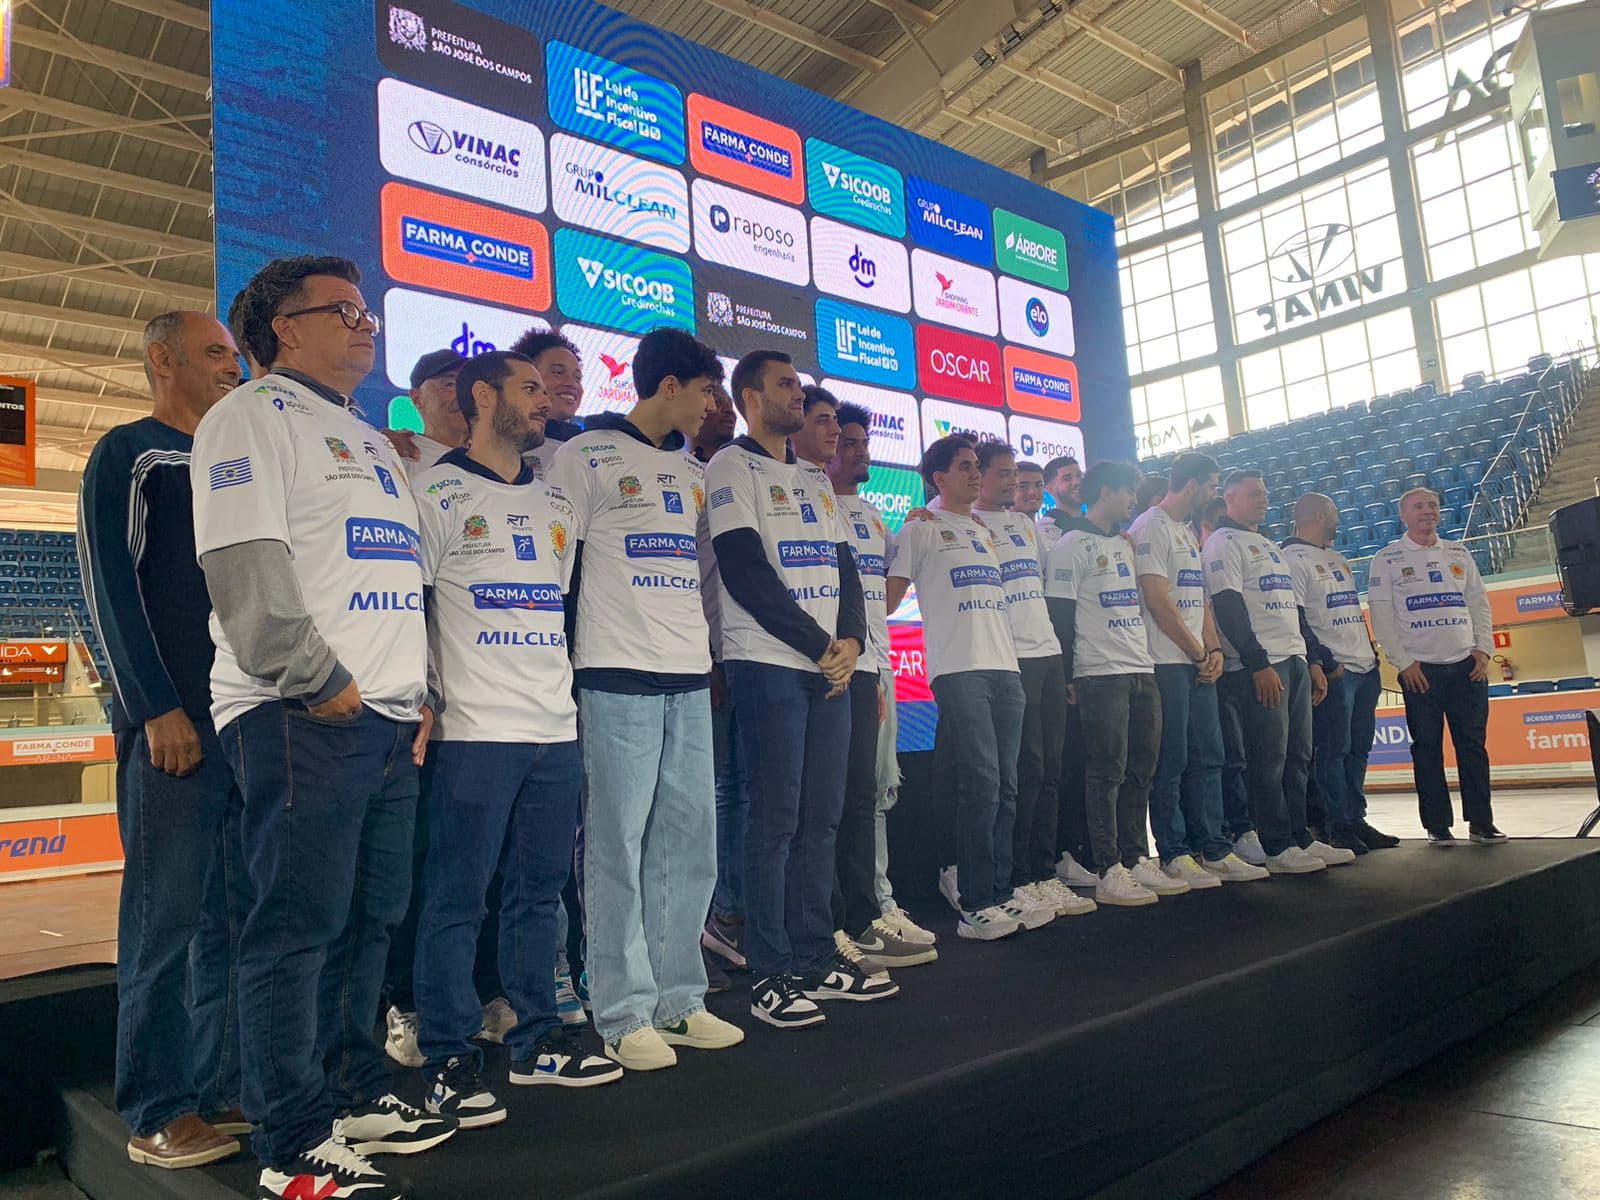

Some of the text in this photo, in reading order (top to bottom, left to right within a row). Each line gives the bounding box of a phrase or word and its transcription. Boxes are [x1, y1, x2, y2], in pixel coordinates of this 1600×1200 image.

[430, 27, 482, 55] PREFEITURA
[431, 39, 533, 85] SÃO JOSÉ DOS CAMPOS
[606, 94, 658, 123] Incentivo
[607, 111, 638, 133] Fiscal
[452, 131, 521, 166] VINAC
[704, 126, 747, 153] FARMA
[748, 142, 790, 168] CONDE
[454, 152, 519, 177] consórcios
[565, 162, 604, 183] GRUPO
[574, 178, 676, 220] MILCLEAN
[841, 173, 892, 205] SICOOB
[852, 194, 892, 216] Credirochas
[917, 197, 941, 213] GRUPO
[733, 214, 795, 248] raposo
[923, 210, 983, 241] MILCLEAN
[405, 222, 467, 252] FARMA
[467, 238, 530, 267] CONDE
[752, 243, 795, 264] engenharia
[1015, 232, 1058, 266] ÁRBORE
[602, 268, 675, 305] SICOOB
[620, 294, 676, 318] Credirochas
[735, 303, 772, 321] PREFEITURA
[1030, 305, 1047, 324] elo
[736, 315, 807, 340] SÃO JOSÉ DOS CAMPOS
[857, 323, 882, 339] Lei de
[858, 337, 896, 356] Incentivo
[859, 353, 882, 368] Fiscal
[930, 349, 992, 384] OSCAR
[1014, 371, 1042, 388] FARMA
[1042, 376, 1070, 394] CONDE
[1034, 439, 1076, 459] raposo
[352, 526, 408, 546] FARMA
[629, 537, 677, 549] FARMA
[781, 545, 819, 557] FARMA
[953, 568, 987, 579] FARMA
[1408, 595, 1440, 607] FARMA
[1518, 595, 1553, 607] FARMA
[1525, 715, 1554, 723] acesse
[1555, 713, 1581, 721] nosso
[15, 739, 91, 752] FARMA CONDE
[1526, 728, 1590, 750] farm
